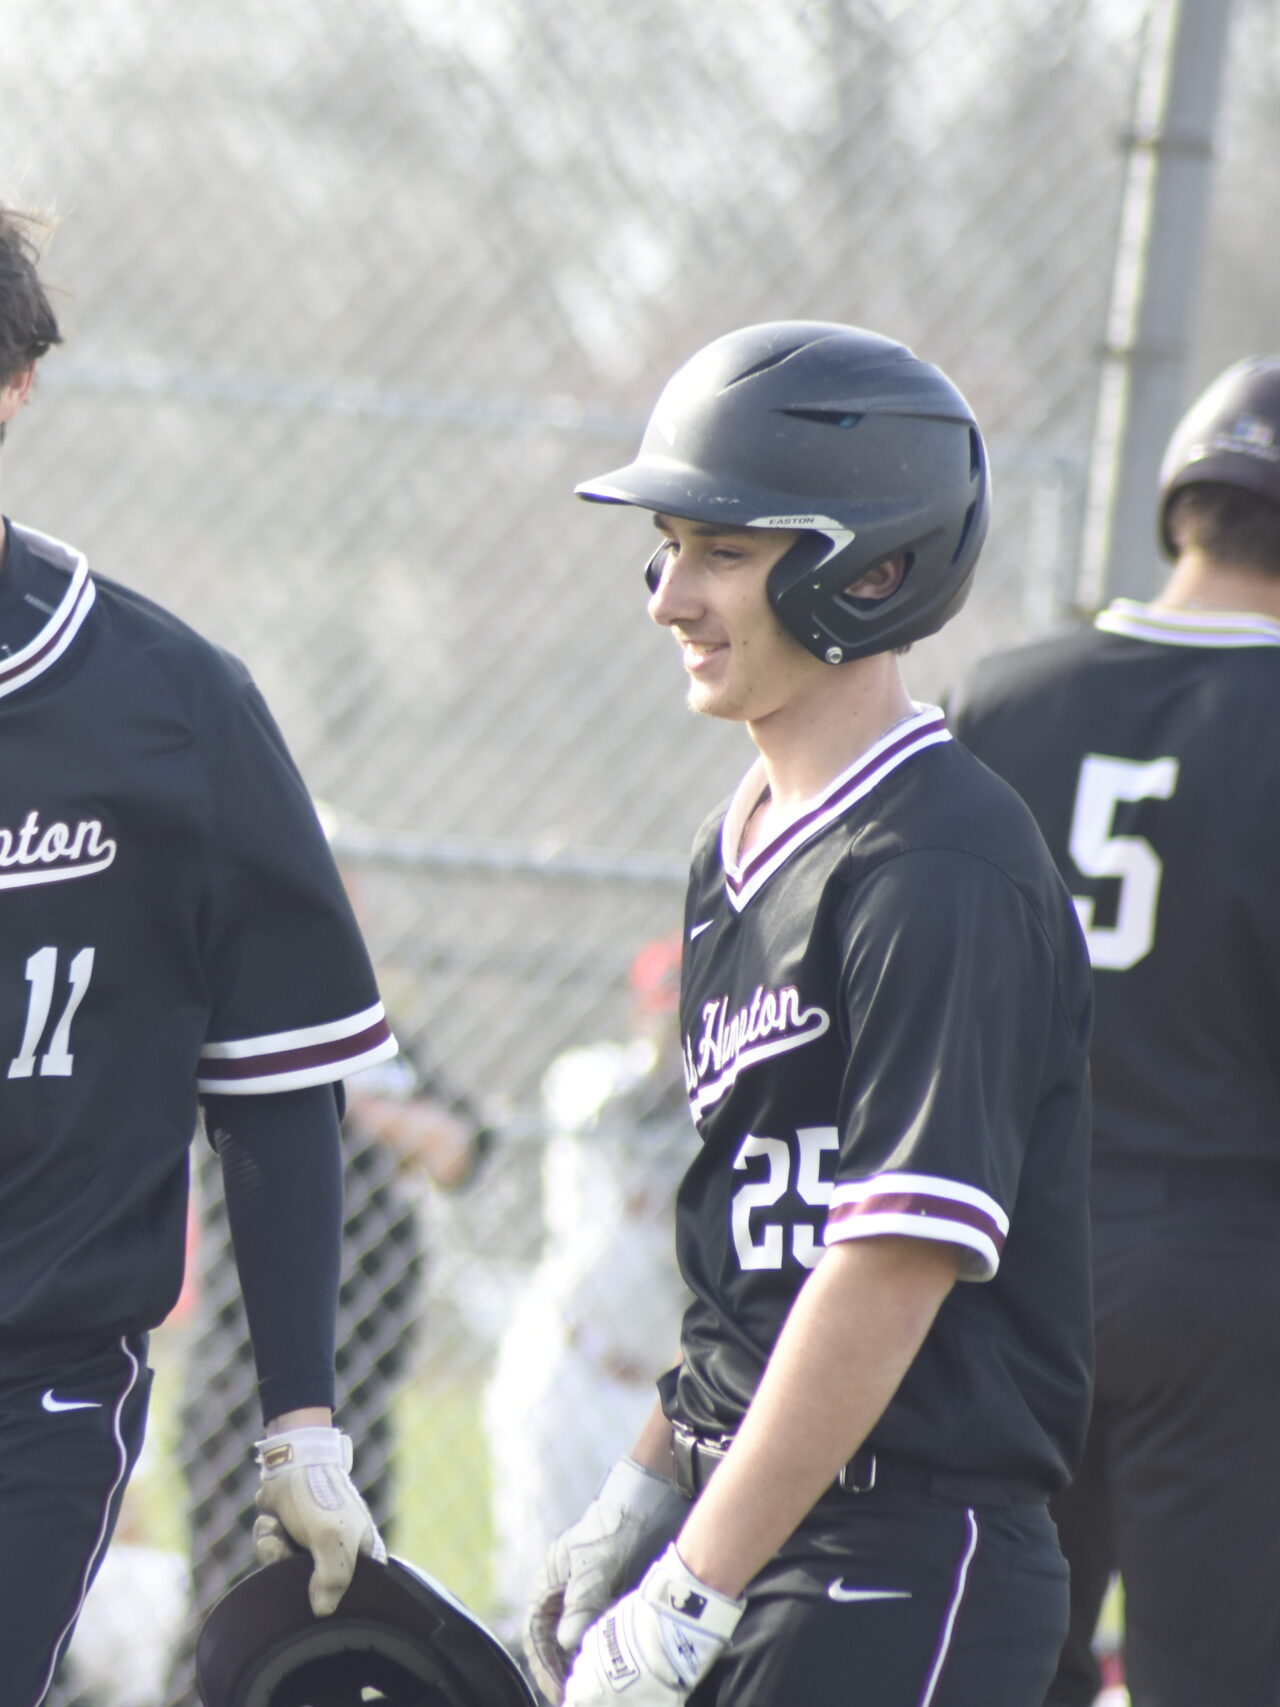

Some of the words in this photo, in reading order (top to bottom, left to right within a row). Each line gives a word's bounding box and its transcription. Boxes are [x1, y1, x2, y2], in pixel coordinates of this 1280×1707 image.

[768, 516, 816, 526] EASTON
[1068, 753, 1180, 971] 5
[7, 946, 96, 1079] 11
[731, 1126, 840, 1271] 25
